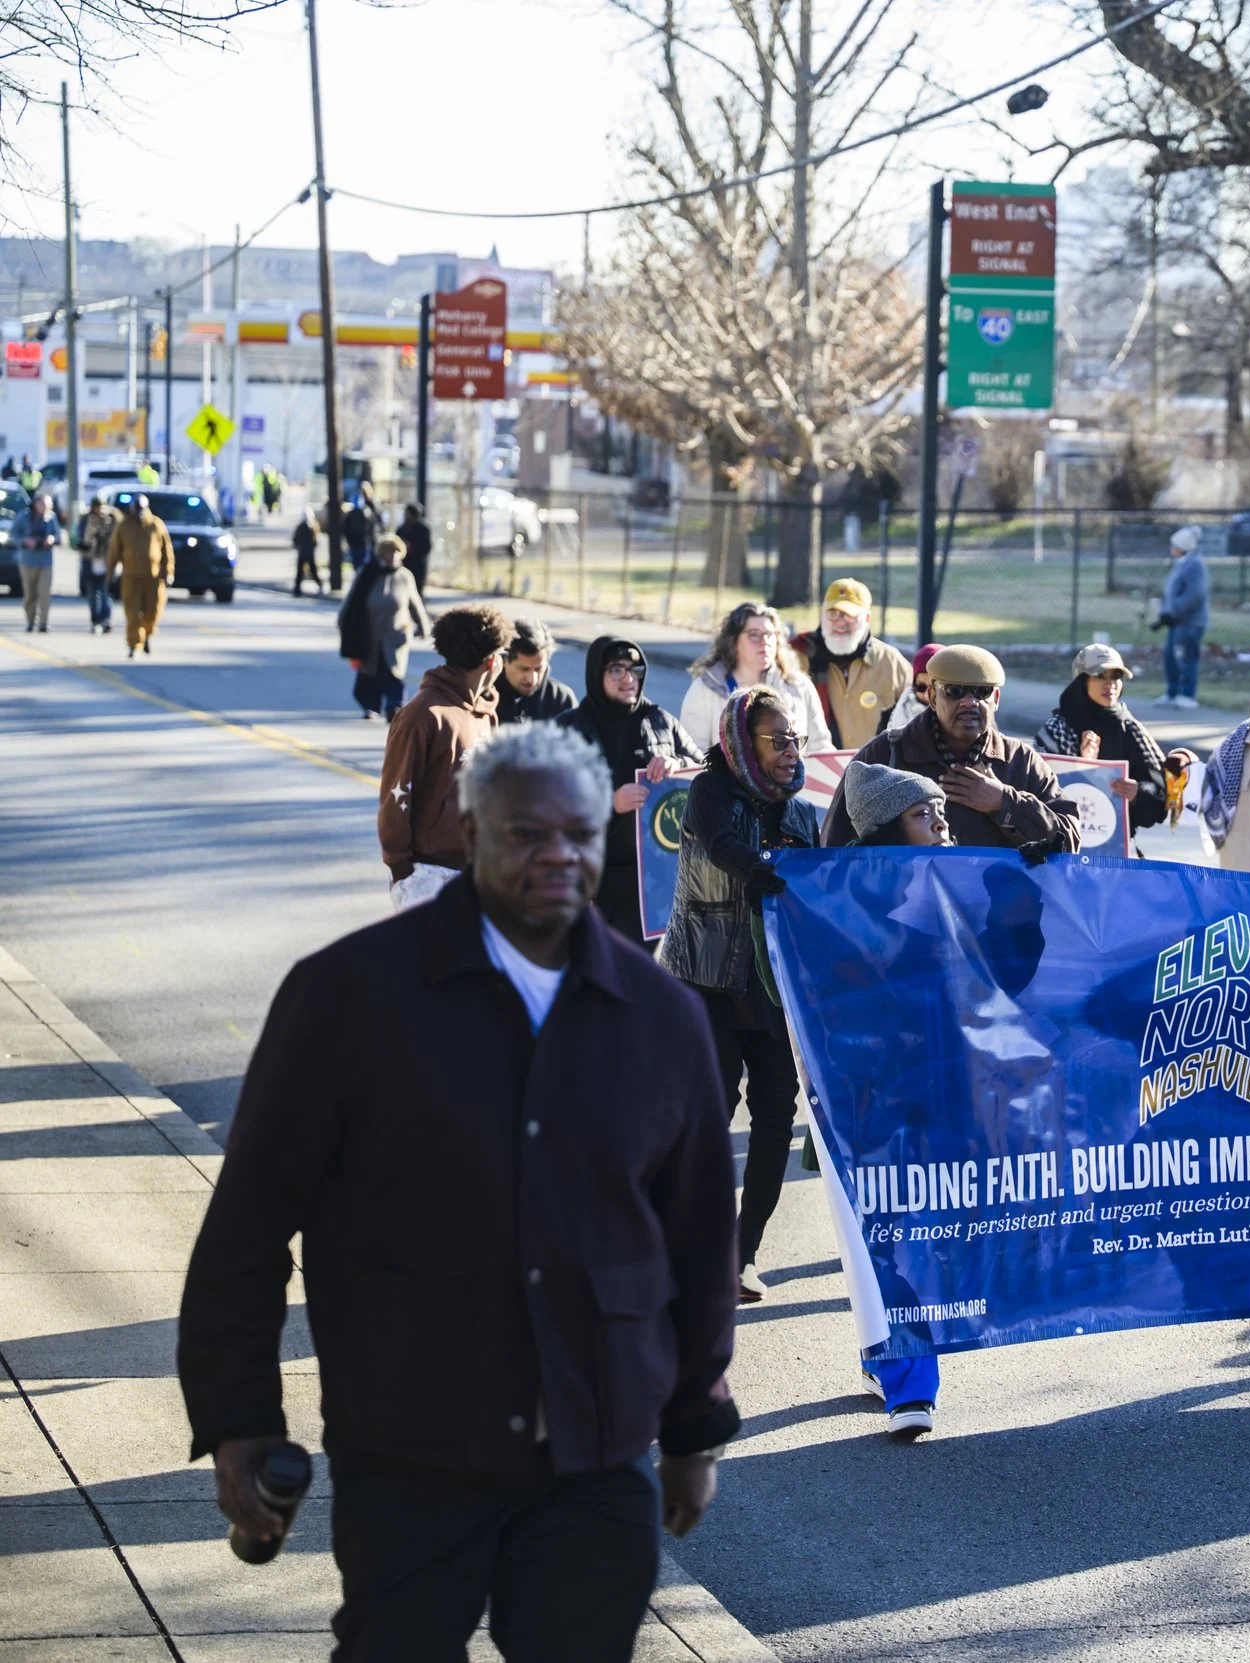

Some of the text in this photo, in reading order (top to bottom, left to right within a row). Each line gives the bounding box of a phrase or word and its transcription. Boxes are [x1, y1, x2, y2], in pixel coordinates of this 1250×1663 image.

[954, 202, 1037, 221] West End
[971, 239, 1034, 256] RIGHT AT
[978, 256, 1027, 272] SIGNAL
[981, 316, 1012, 340] 40
[1016, 309, 1049, 324] EAST
[968, 372, 1031, 388] RIGHT AT
[975, 389, 1024, 404] SIGNAL
[1080, 823, 1108, 832] MAC
[847, 1160, 977, 1215] UILDING
[986, 1150, 1064, 1204] FAITH.
[1073, 1138, 1200, 1195] BUILDING
[868, 1222, 903, 1243] fe's
[909, 1221, 960, 1240] most
[966, 1208, 1057, 1242] persistent
[1061, 1202, 1094, 1225] and
[1100, 1199, 1163, 1226] urgent
[1092, 1236, 1123, 1255] Rev.
[1128, 1233, 1153, 1251] Dr.
[1156, 1227, 1215, 1248] Martin
[886, 1298, 986, 1325] ATENORTHNASH.ORG
